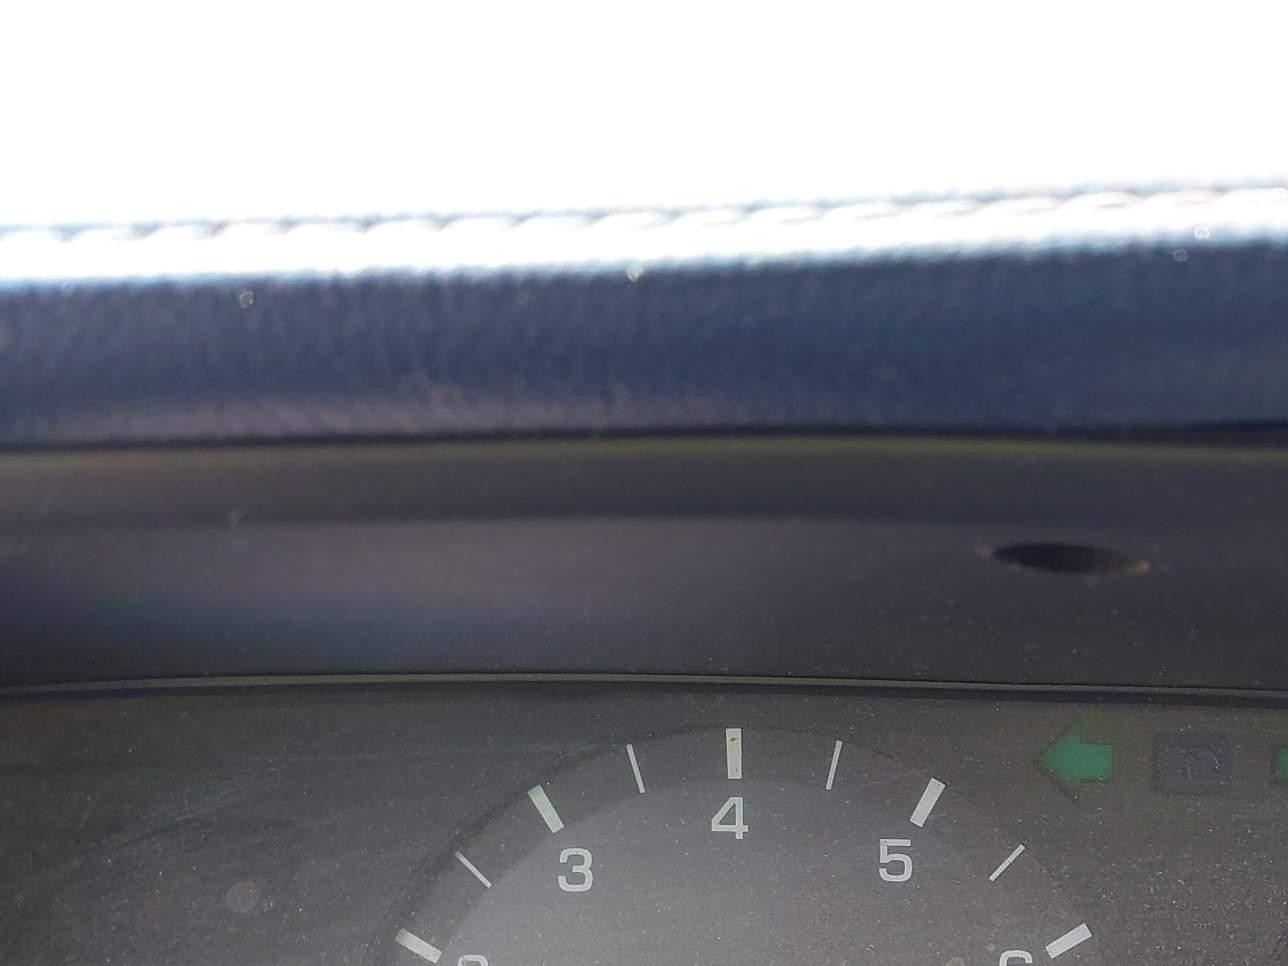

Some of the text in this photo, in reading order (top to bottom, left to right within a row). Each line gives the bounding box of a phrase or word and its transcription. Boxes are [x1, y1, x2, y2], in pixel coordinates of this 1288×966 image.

[711, 797, 749, 839] 4
[558, 848, 593, 891] 3
[879, 838, 912, 882] 5
